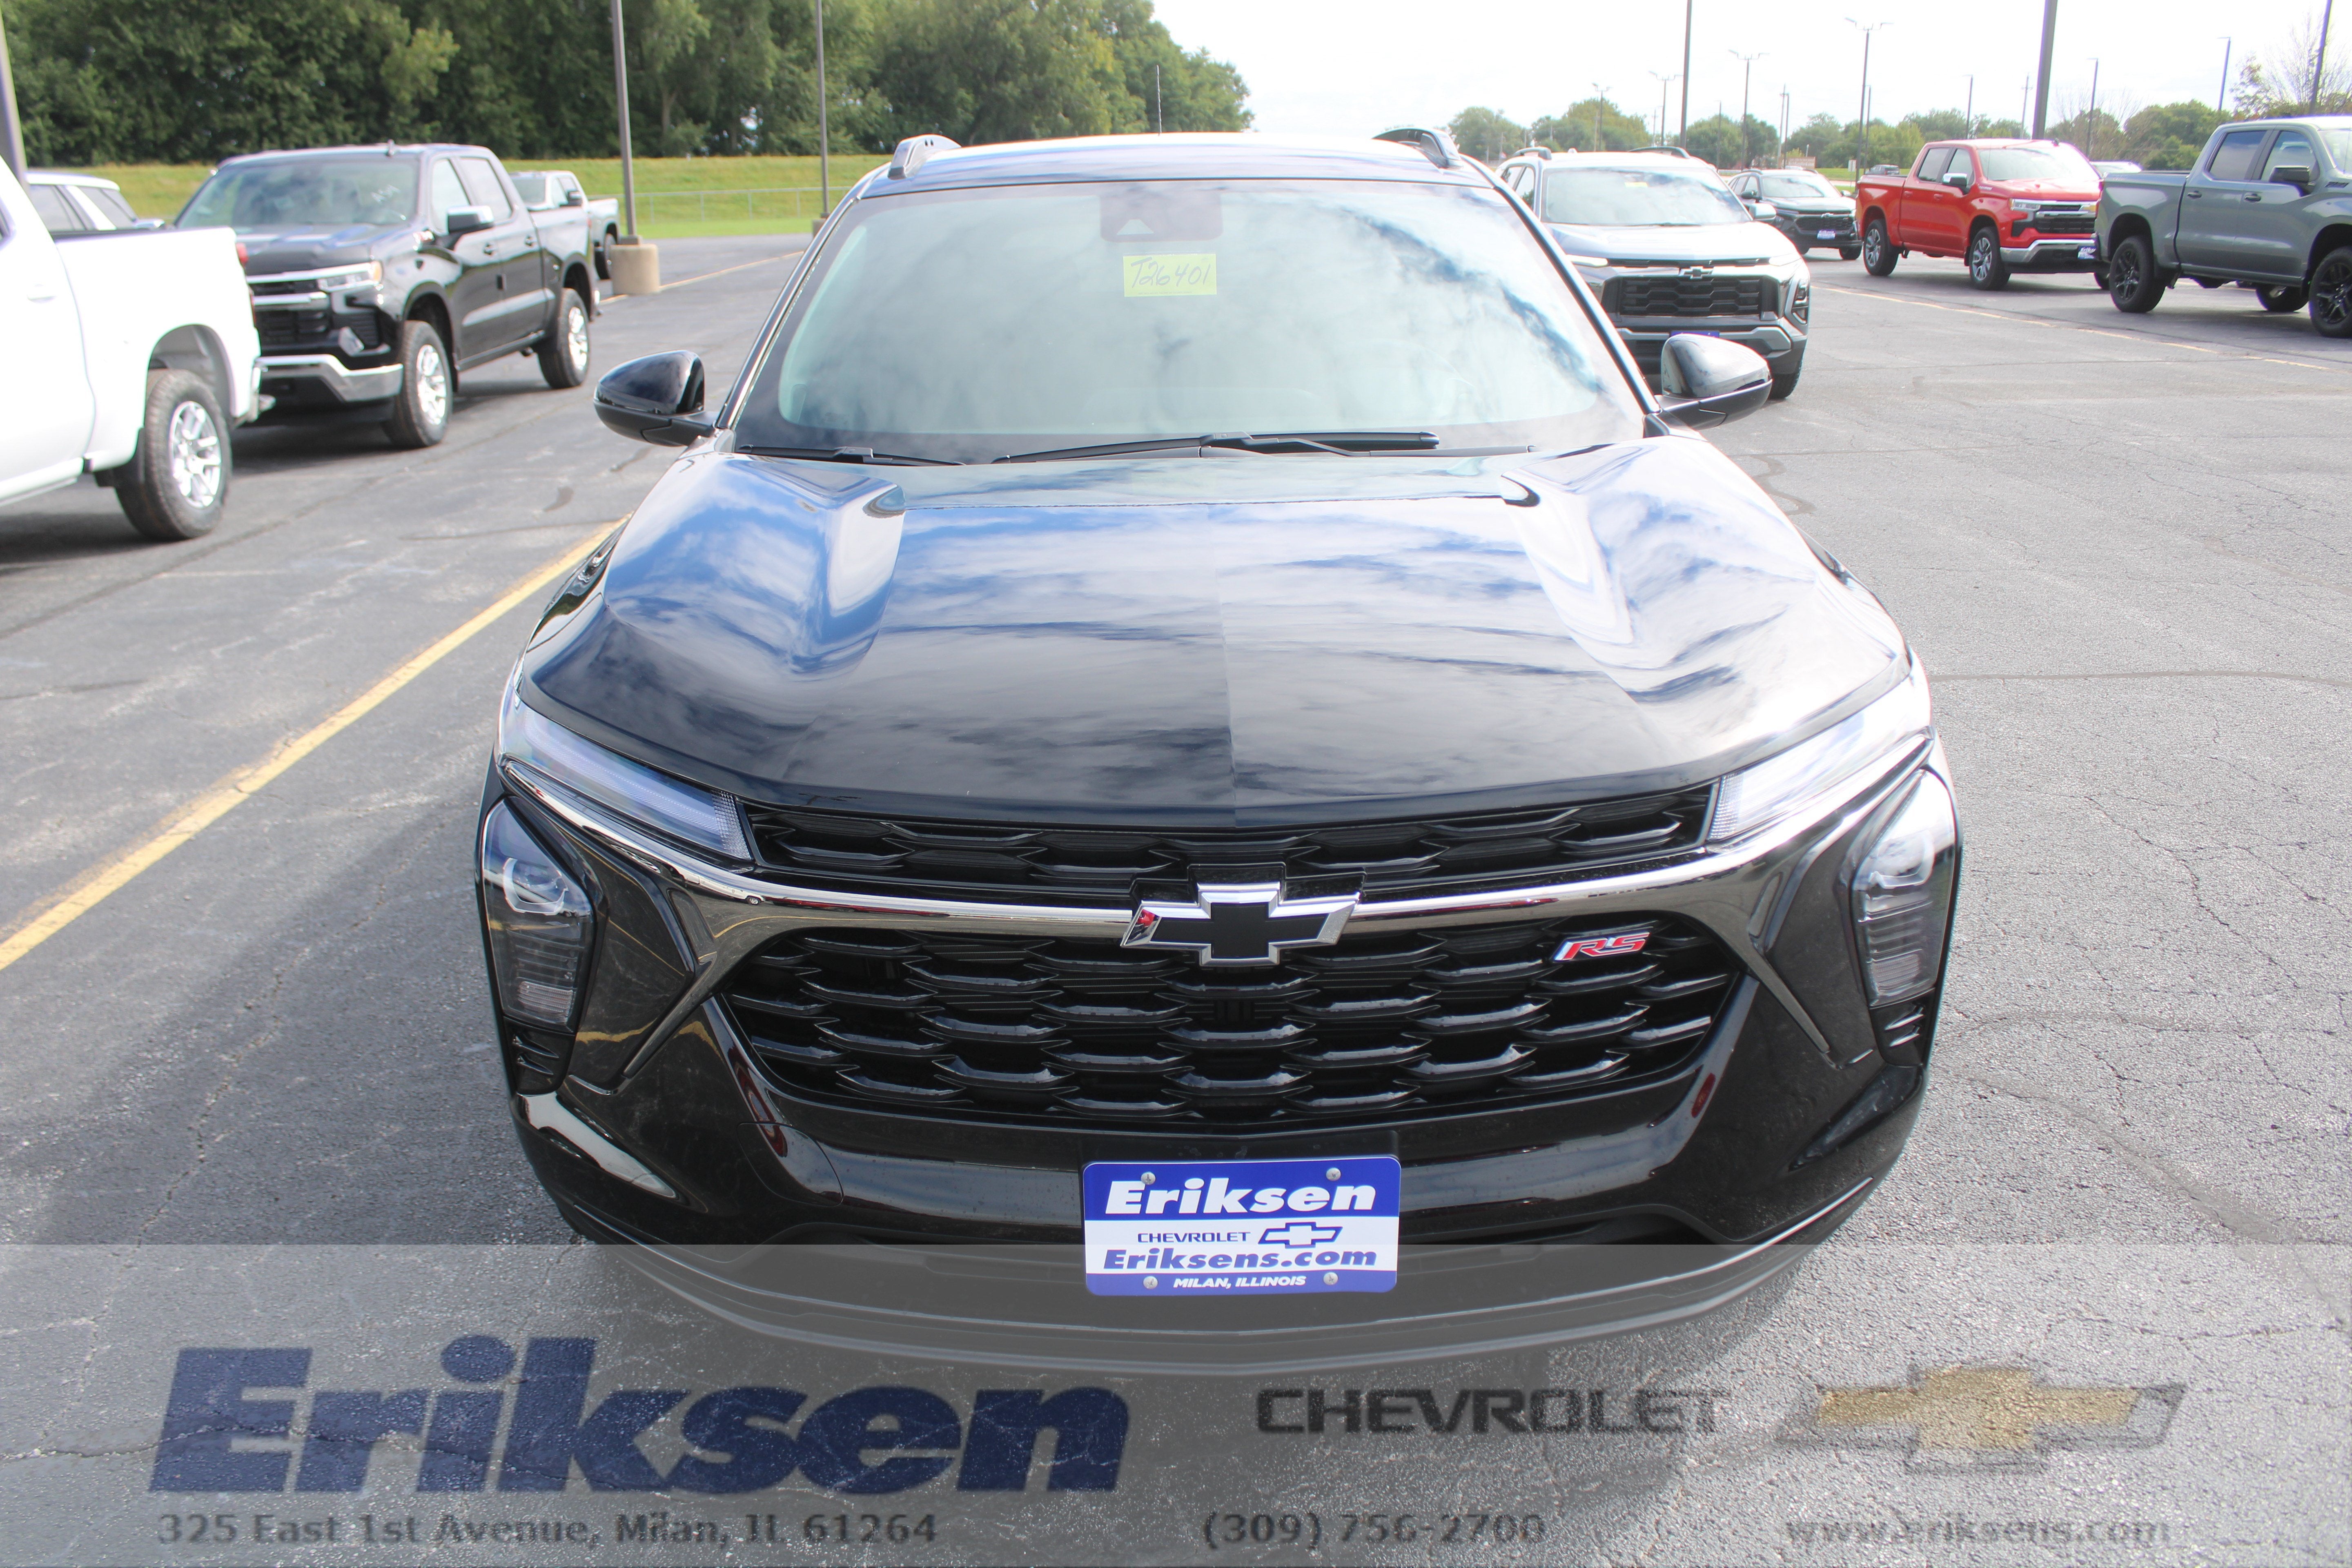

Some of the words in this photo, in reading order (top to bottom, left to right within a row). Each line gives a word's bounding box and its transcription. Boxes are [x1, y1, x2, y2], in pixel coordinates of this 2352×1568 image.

[1130, 256, 1211, 288] T26401
[1553, 931, 1653, 962] RS
[1105, 1178, 1376, 1214] Eriksen
[1138, 1232, 1251, 1243] CHEVROLET
[1103, 1247, 1376, 1270] Eriksens.com
[1173, 1276, 1232, 1289] MILAN,
[1235, 1275, 1307, 1288] ILLINOIS
